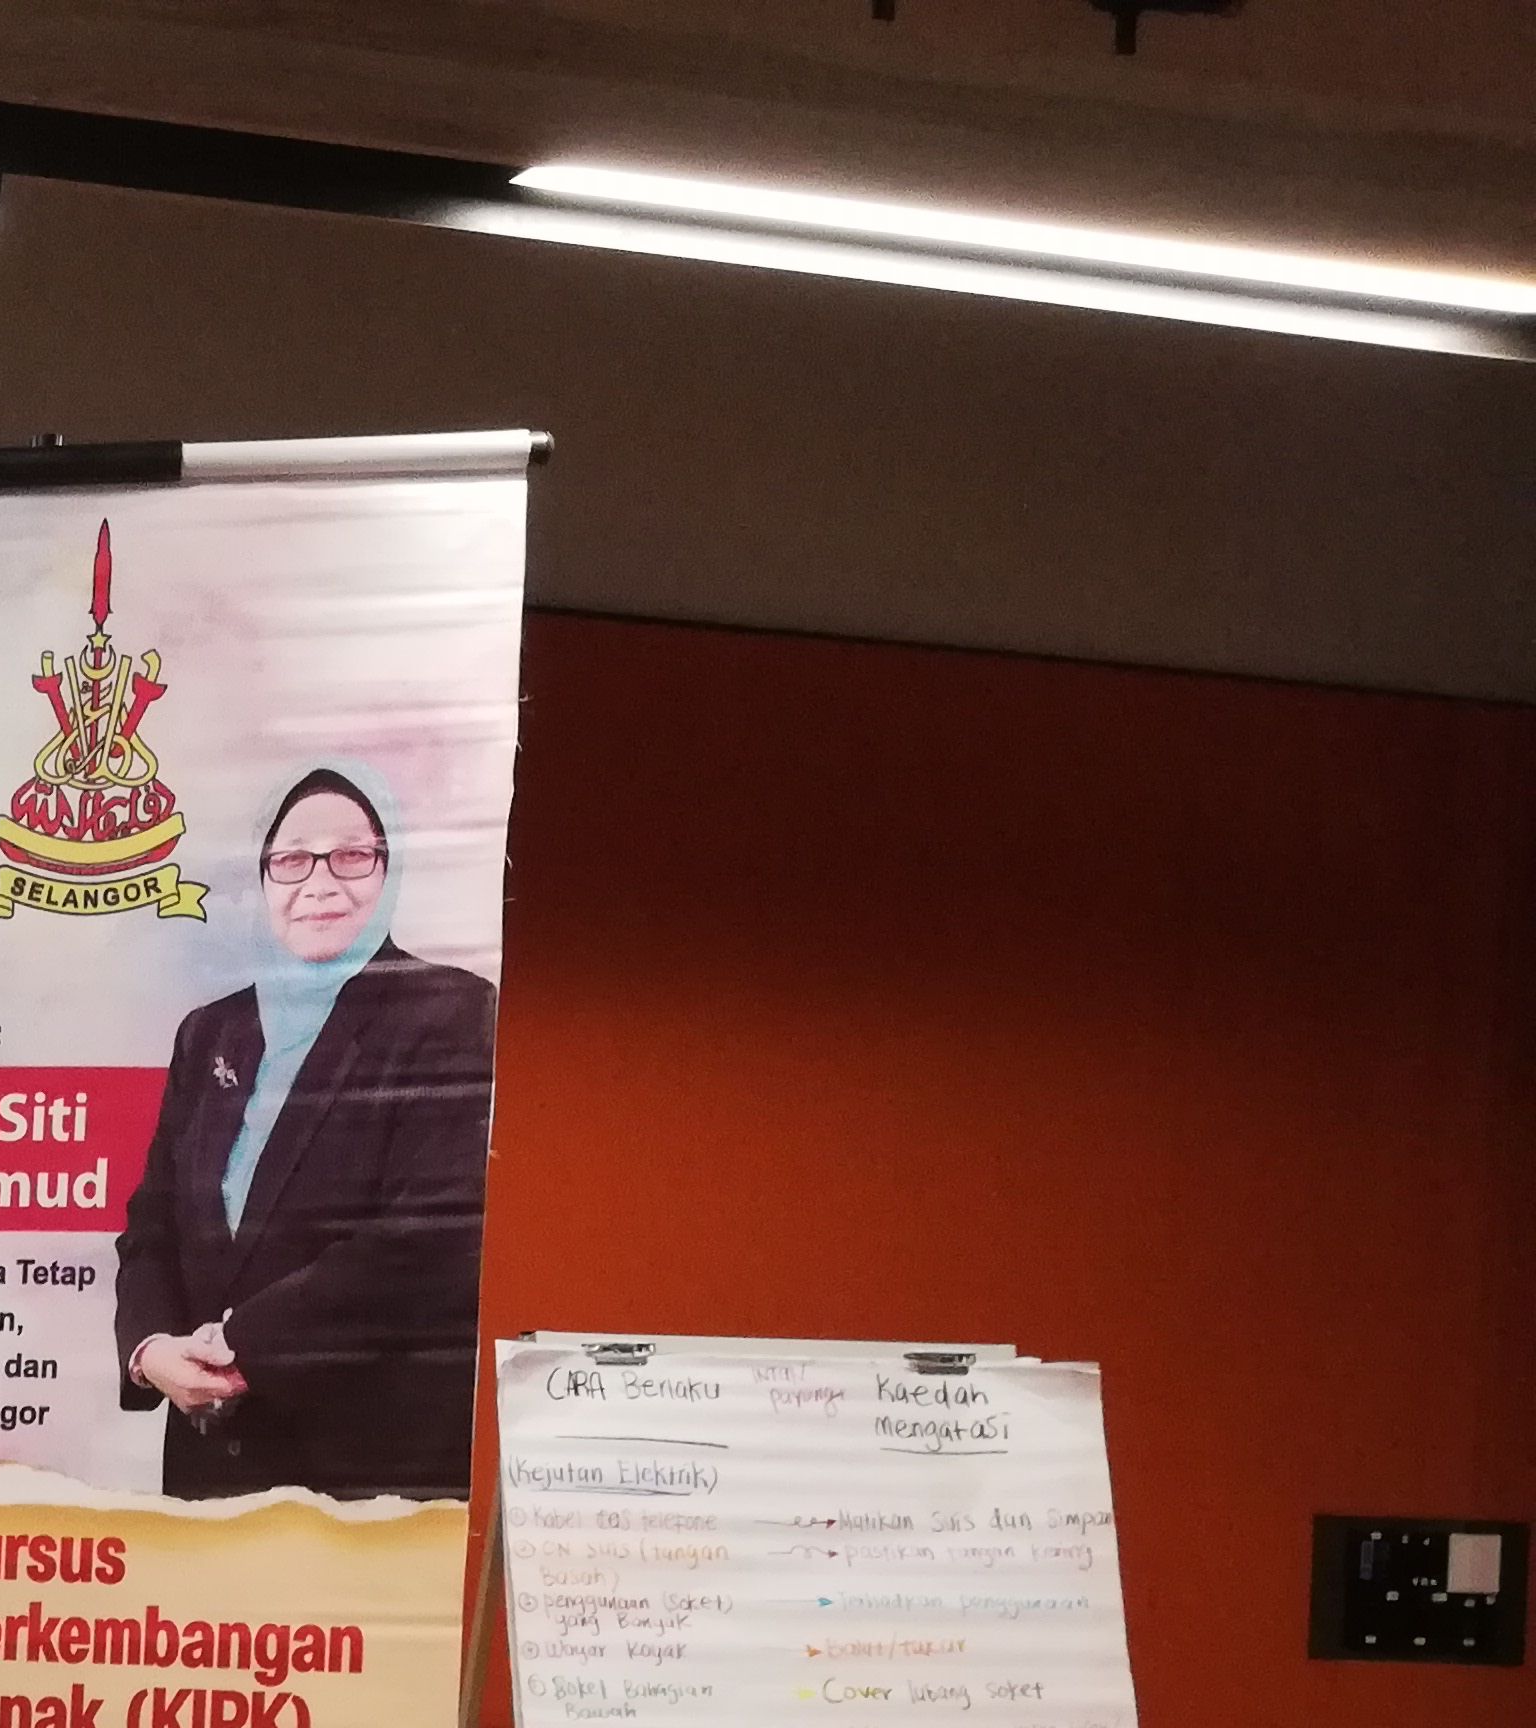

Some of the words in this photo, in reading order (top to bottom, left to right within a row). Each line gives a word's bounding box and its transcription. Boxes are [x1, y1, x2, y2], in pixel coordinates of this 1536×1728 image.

[10, 877, 162, 909] SELANGOR
[16, 1259, 96, 1292] Tetap
[4, 1353, 58, 1379] dan
[546, 1367, 607, 1401] CARA
[875, 1373, 989, 1410] Kaedah
[822, 1677, 894, 1704] Cover
